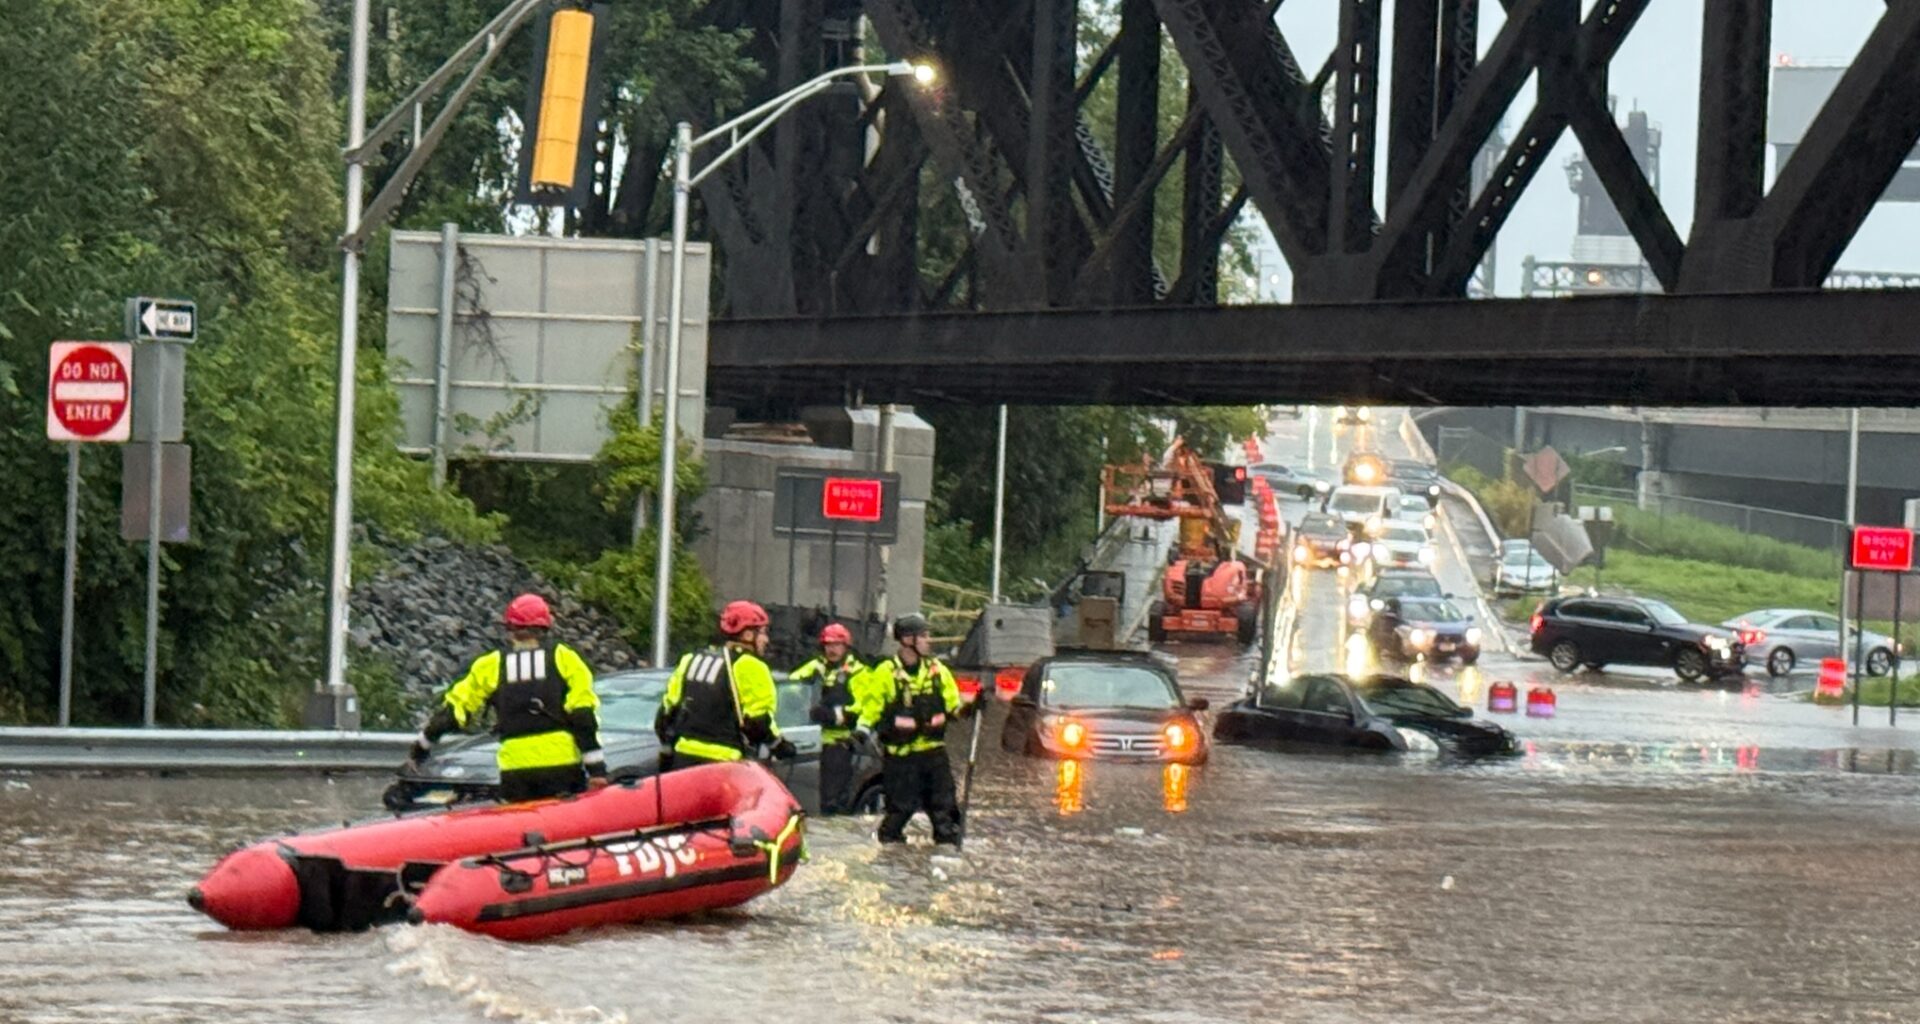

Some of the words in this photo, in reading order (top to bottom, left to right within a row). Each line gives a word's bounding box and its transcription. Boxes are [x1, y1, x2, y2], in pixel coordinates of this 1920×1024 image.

[62, 362, 83, 379] DO
[89, 362, 118, 380] NOT
[66, 405, 112, 421] ENTER
[832, 485, 874, 500] WRONG
[839, 500, 865, 513] WAY
[1862, 535, 1905, 549] WRONG
[1870, 549, 1895, 562] WAY
